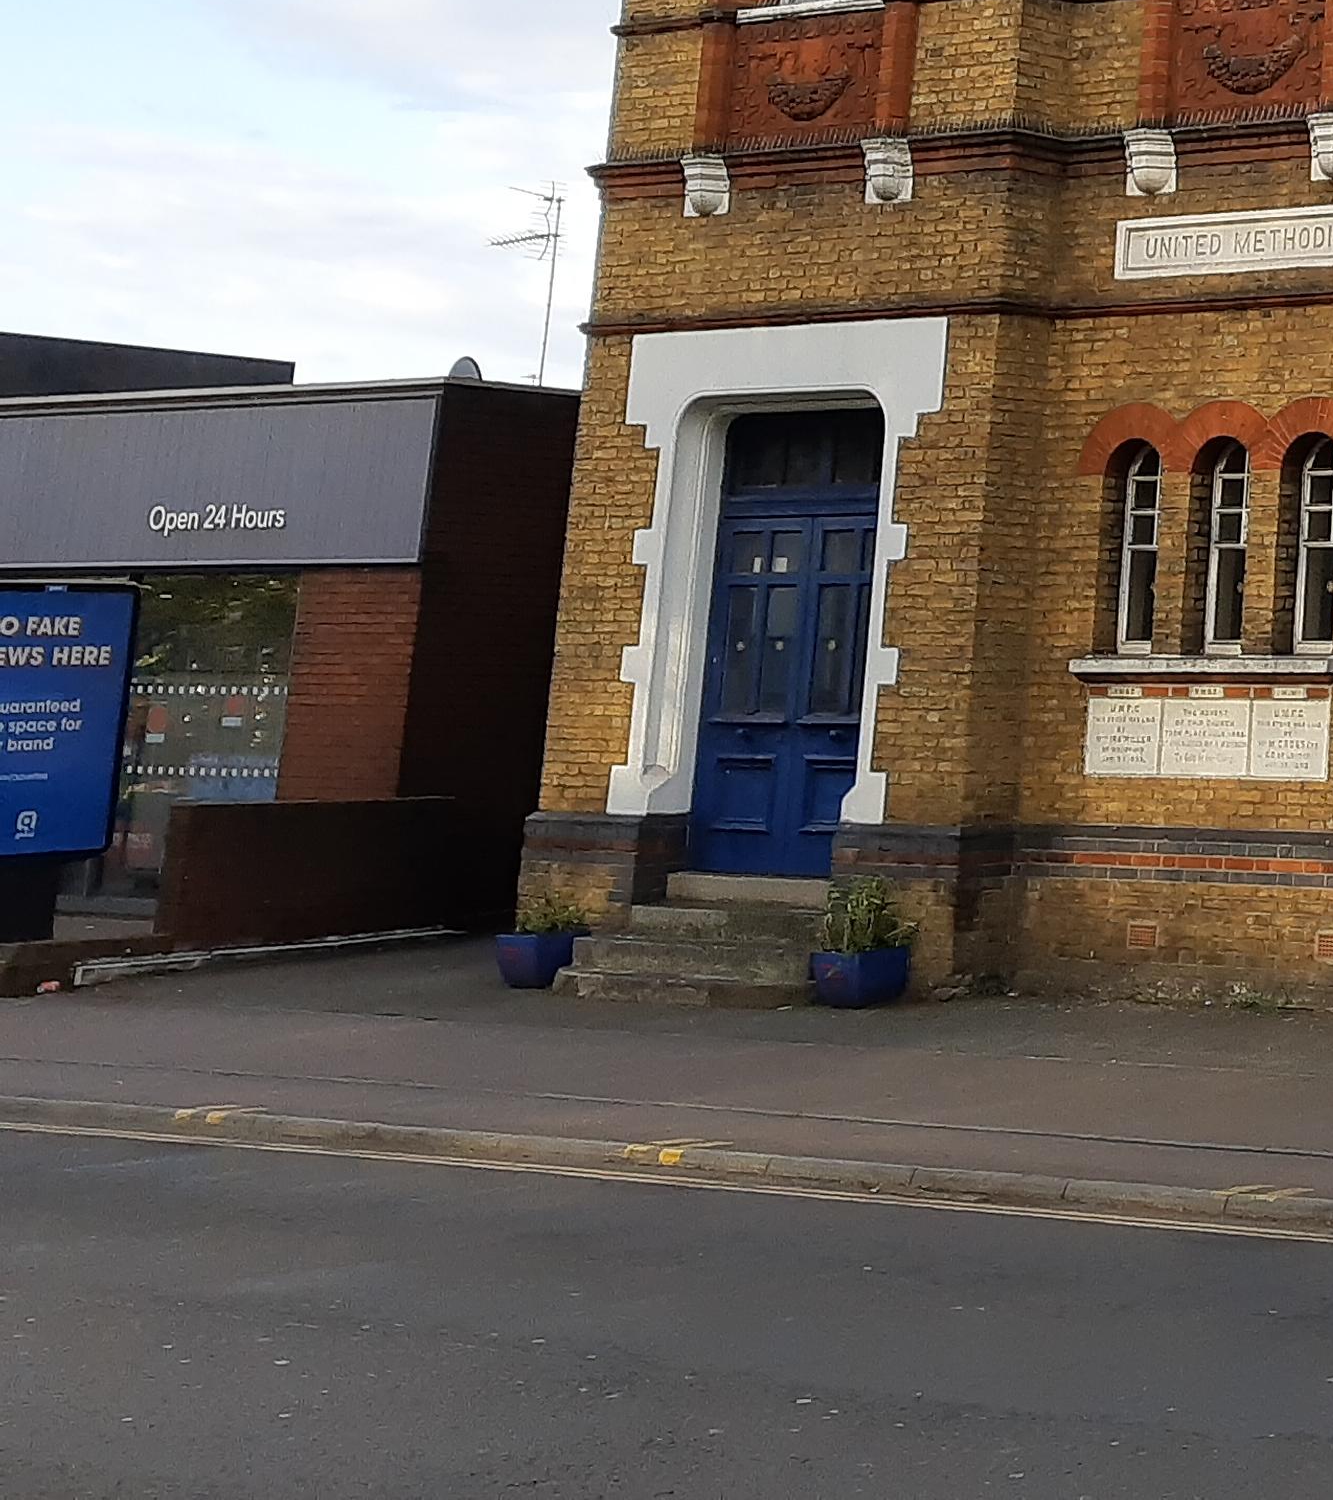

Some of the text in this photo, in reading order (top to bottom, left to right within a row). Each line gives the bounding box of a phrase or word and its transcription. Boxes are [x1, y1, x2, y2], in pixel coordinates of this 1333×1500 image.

[1145, 234, 1222, 258] UNITED
[149, 504, 285, 536] Open 24 Hours
[26, 616, 81, 636] FAKE
[52, 645, 112, 667] HERE
[8, 718, 83, 735] space for
[7, 737, 54, 752] brand
